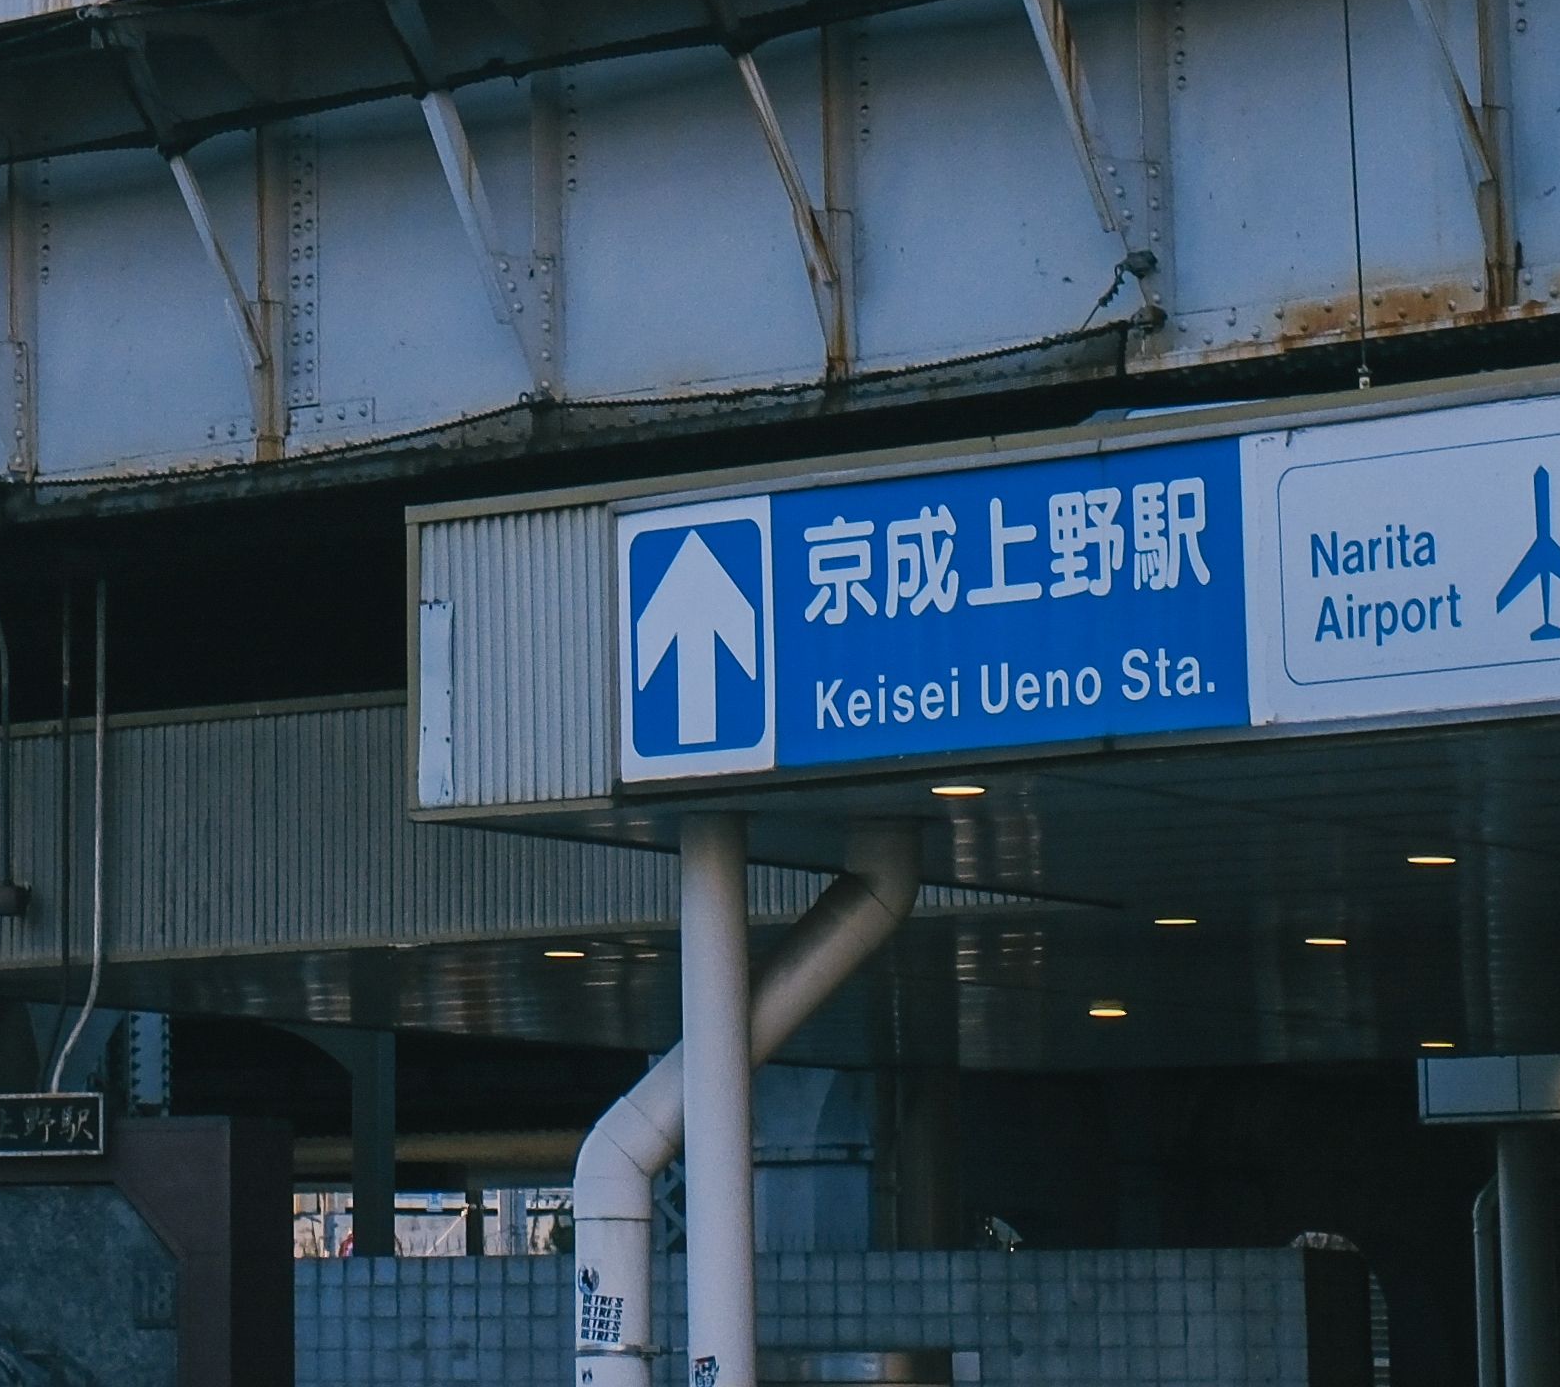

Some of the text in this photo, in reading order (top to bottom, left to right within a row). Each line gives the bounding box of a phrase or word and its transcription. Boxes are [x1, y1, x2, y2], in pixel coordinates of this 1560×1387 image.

[804, 476, 1210, 625] 京成上野駅
[1310, 524, 1436, 578] Narita
[1314, 584, 1462, 646] Airport
[816, 647, 1216, 730] Keisei Ueno Sta.
